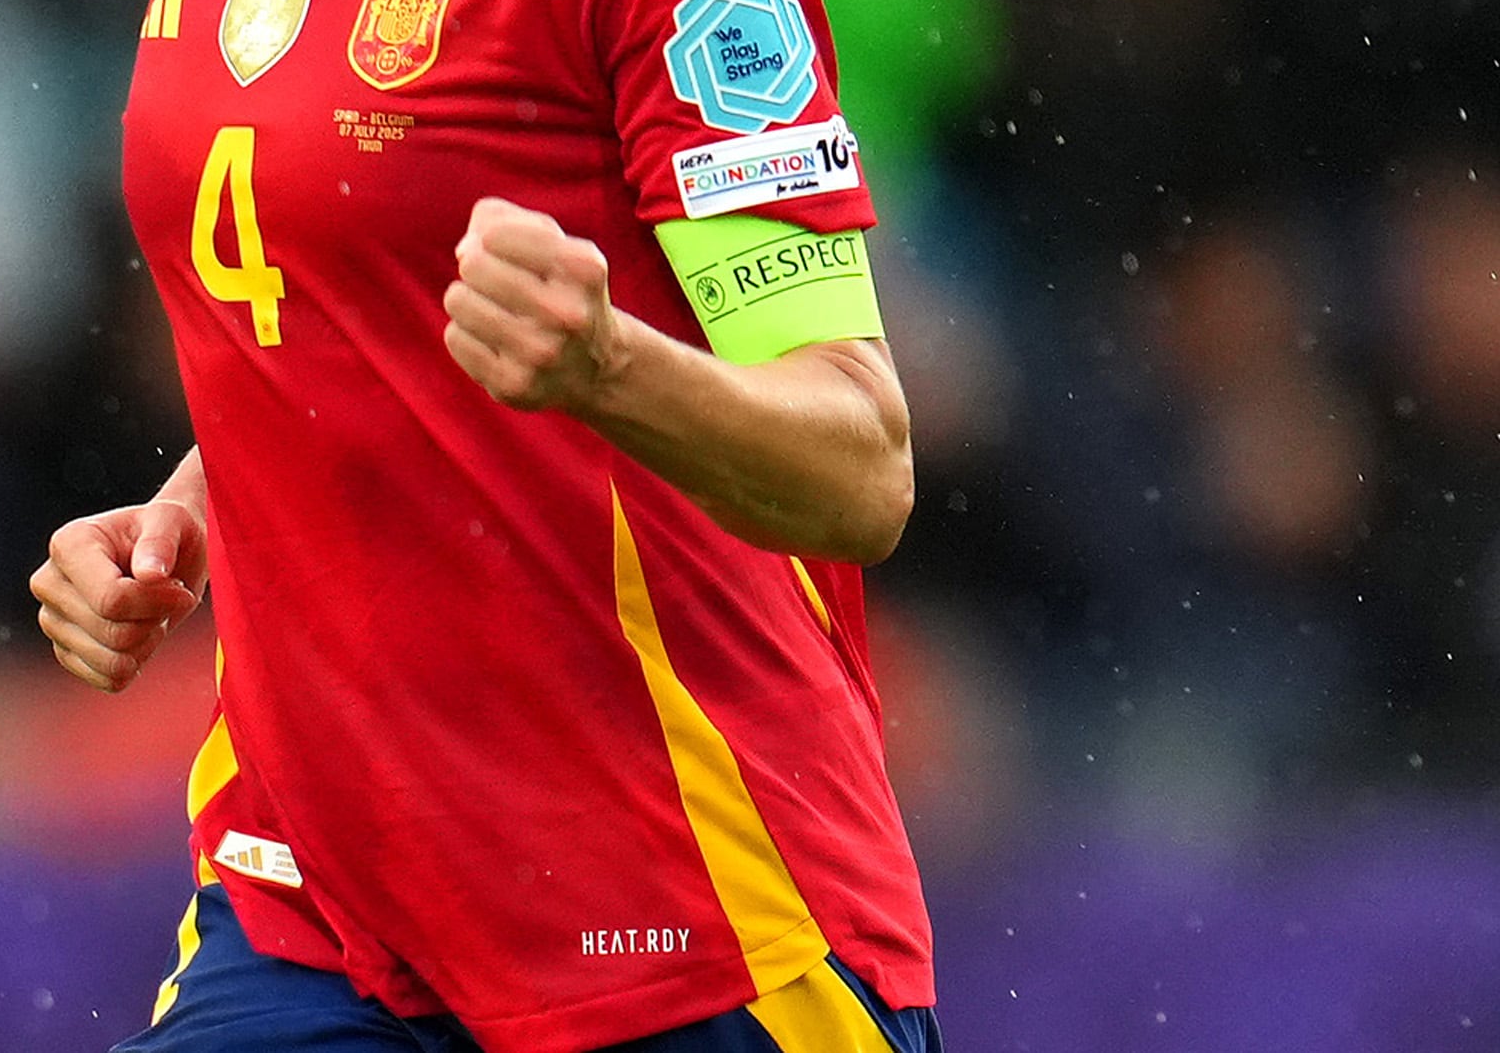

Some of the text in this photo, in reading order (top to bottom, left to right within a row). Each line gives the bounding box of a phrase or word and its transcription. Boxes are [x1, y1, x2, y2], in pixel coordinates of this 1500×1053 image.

[714, 27, 742, 43] We
[721, 42, 760, 64] Play
[726, 52, 784, 81] Strong
[339, 123, 405, 140] 07 JULY 2025
[370, 112, 415, 127] BELGIUM
[680, 153, 714, 170] UEFA
[683, 154, 816, 194] FOUNDATION
[191, 126, 285, 347] 4
[733, 237, 857, 294] RESPECT
[581, 928, 690, 955] HEAT.RDY
